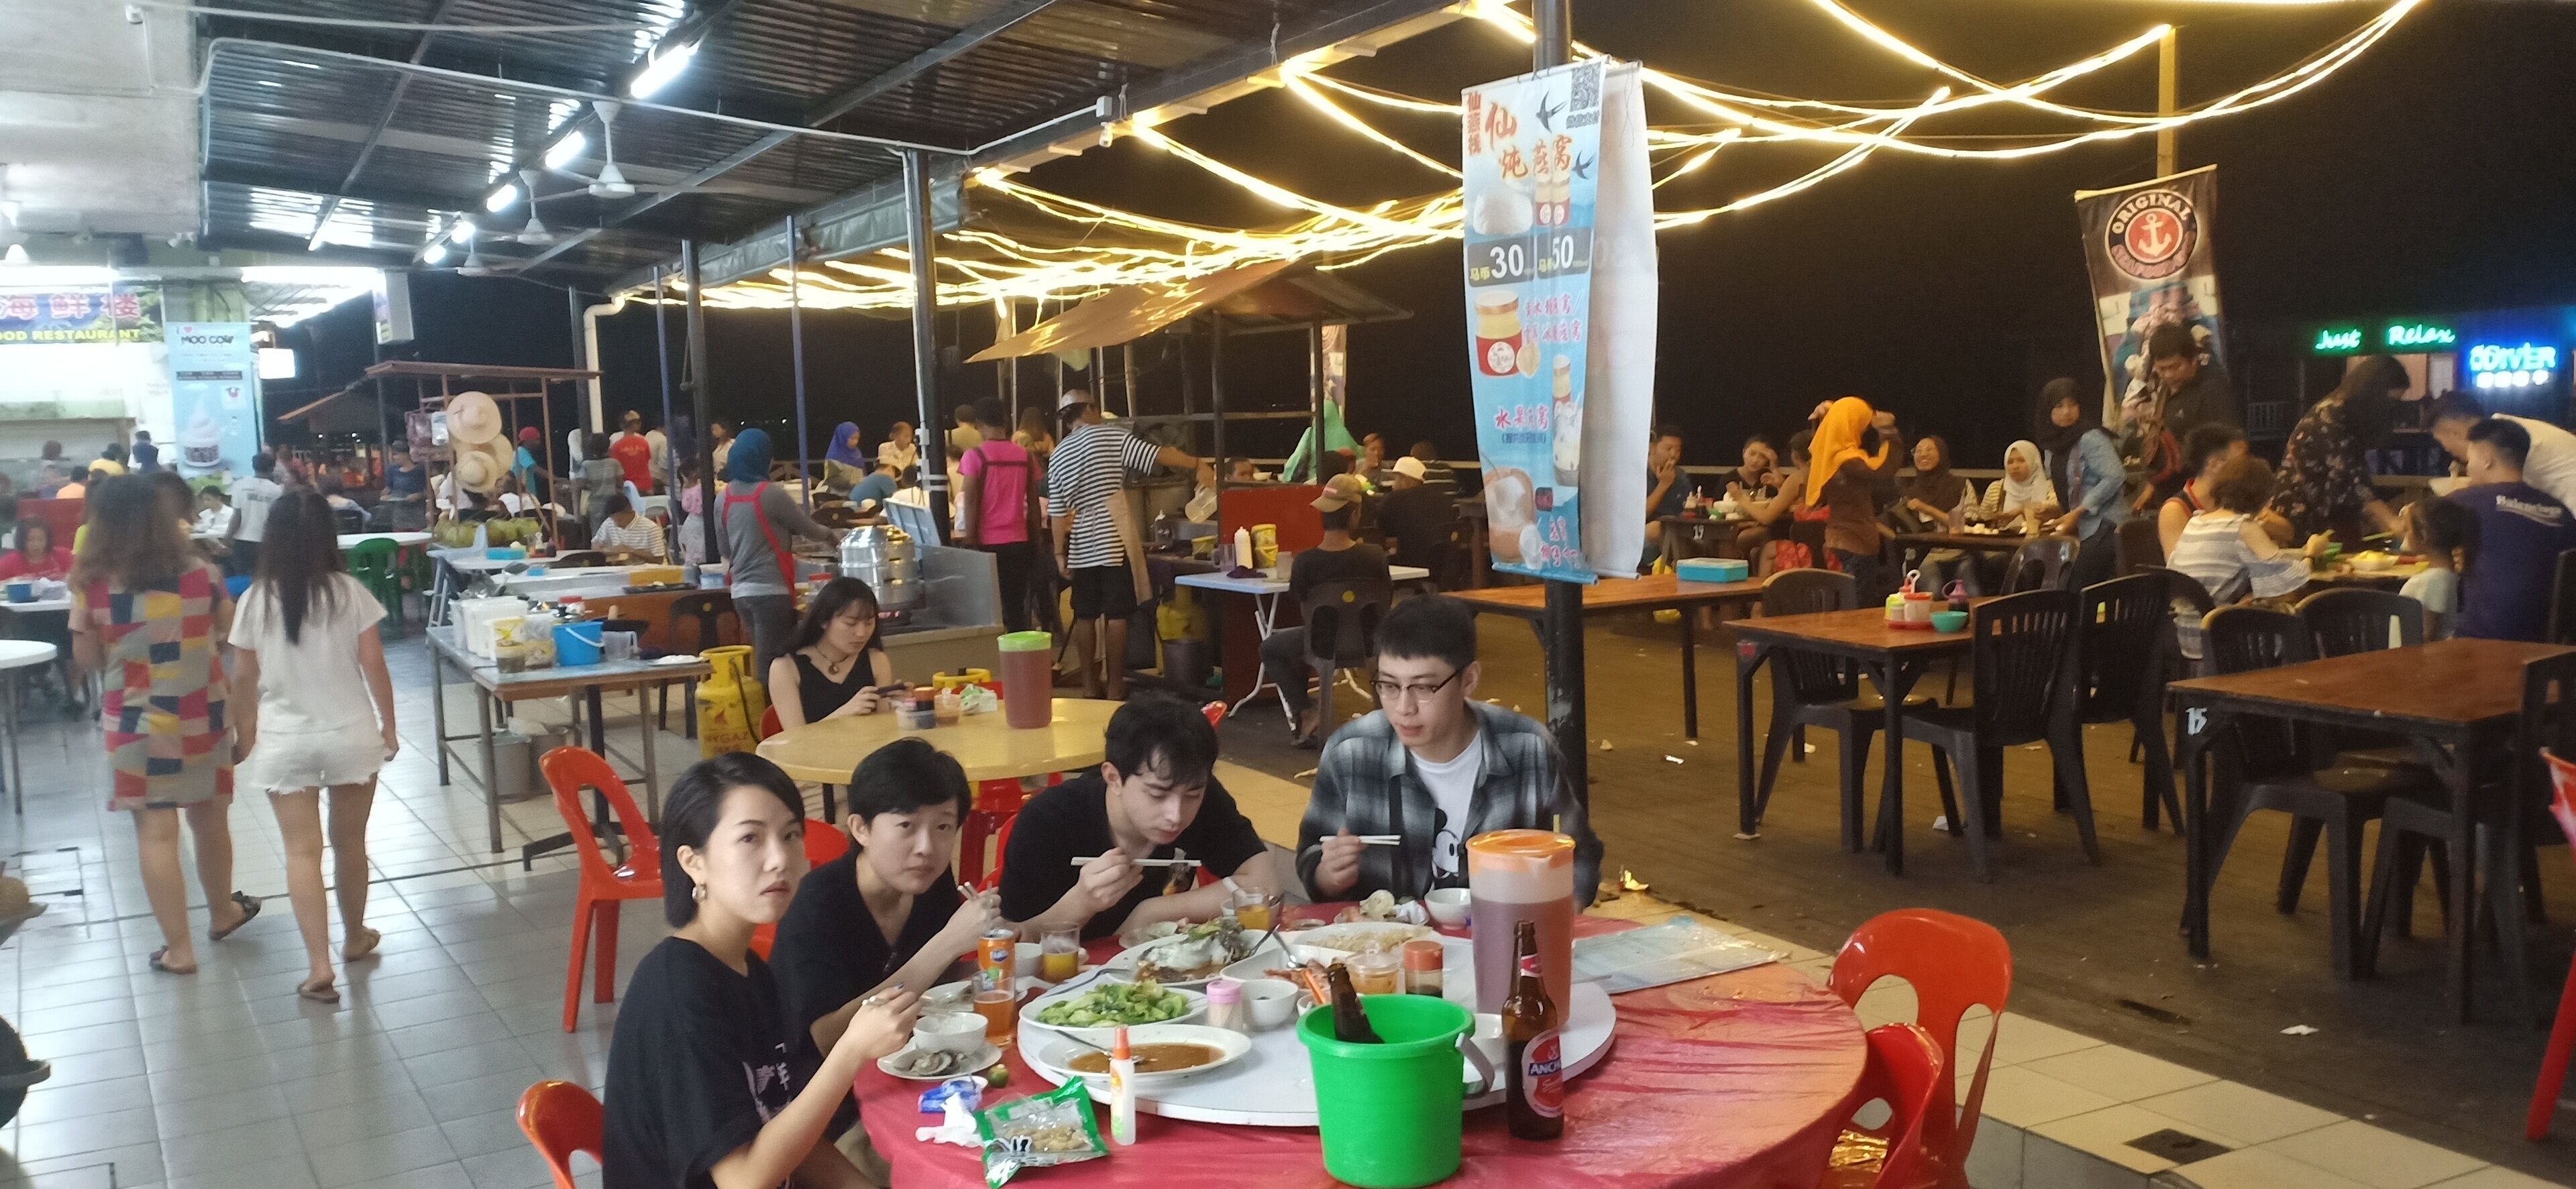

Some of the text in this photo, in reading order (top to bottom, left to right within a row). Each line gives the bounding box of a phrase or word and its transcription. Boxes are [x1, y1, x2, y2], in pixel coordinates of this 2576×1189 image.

[2112, 194, 2191, 234] ORIGINAL
[1490, 243, 1524, 279] 30
[1552, 235, 1574, 270] 50
[0, 329, 140, 341] OD RESTAURANT
[181, 335, 233, 345] MOO COW
[2315, 324, 2456, 349] Just Relax
